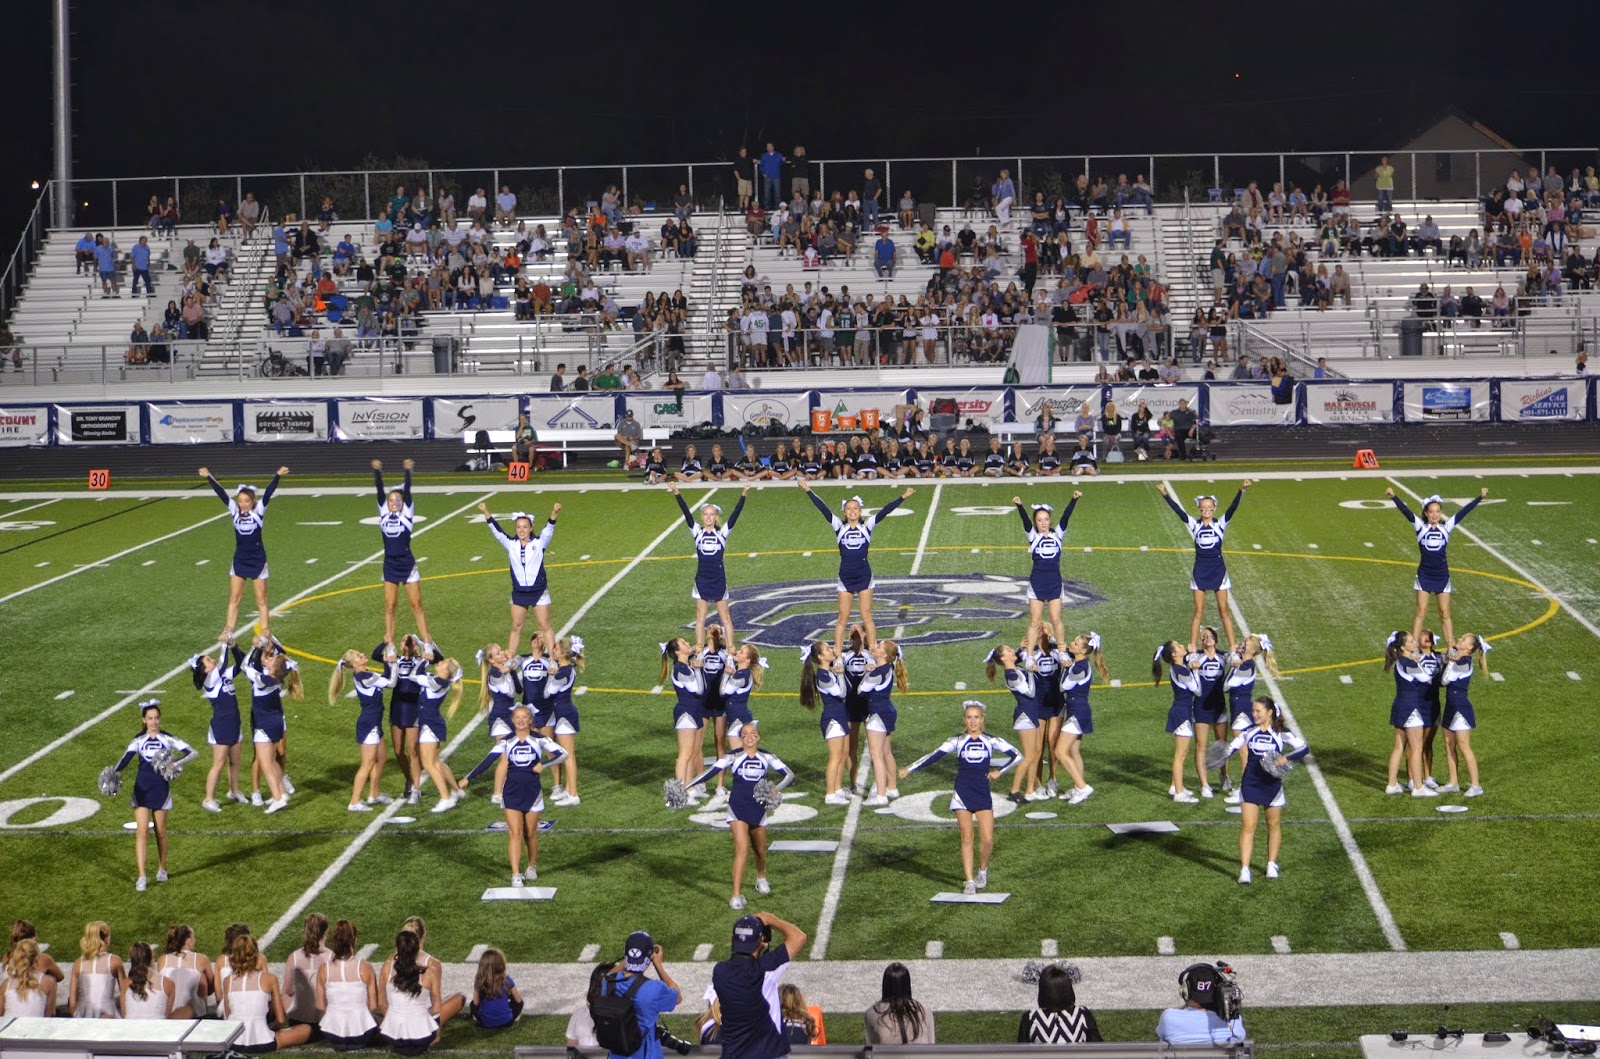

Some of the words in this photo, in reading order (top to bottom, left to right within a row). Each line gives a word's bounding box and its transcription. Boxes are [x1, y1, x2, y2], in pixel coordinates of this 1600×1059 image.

[92, 472, 106, 486] 30
[511, 465, 525, 479] 40
[1197, 981, 1212, 990] 87
